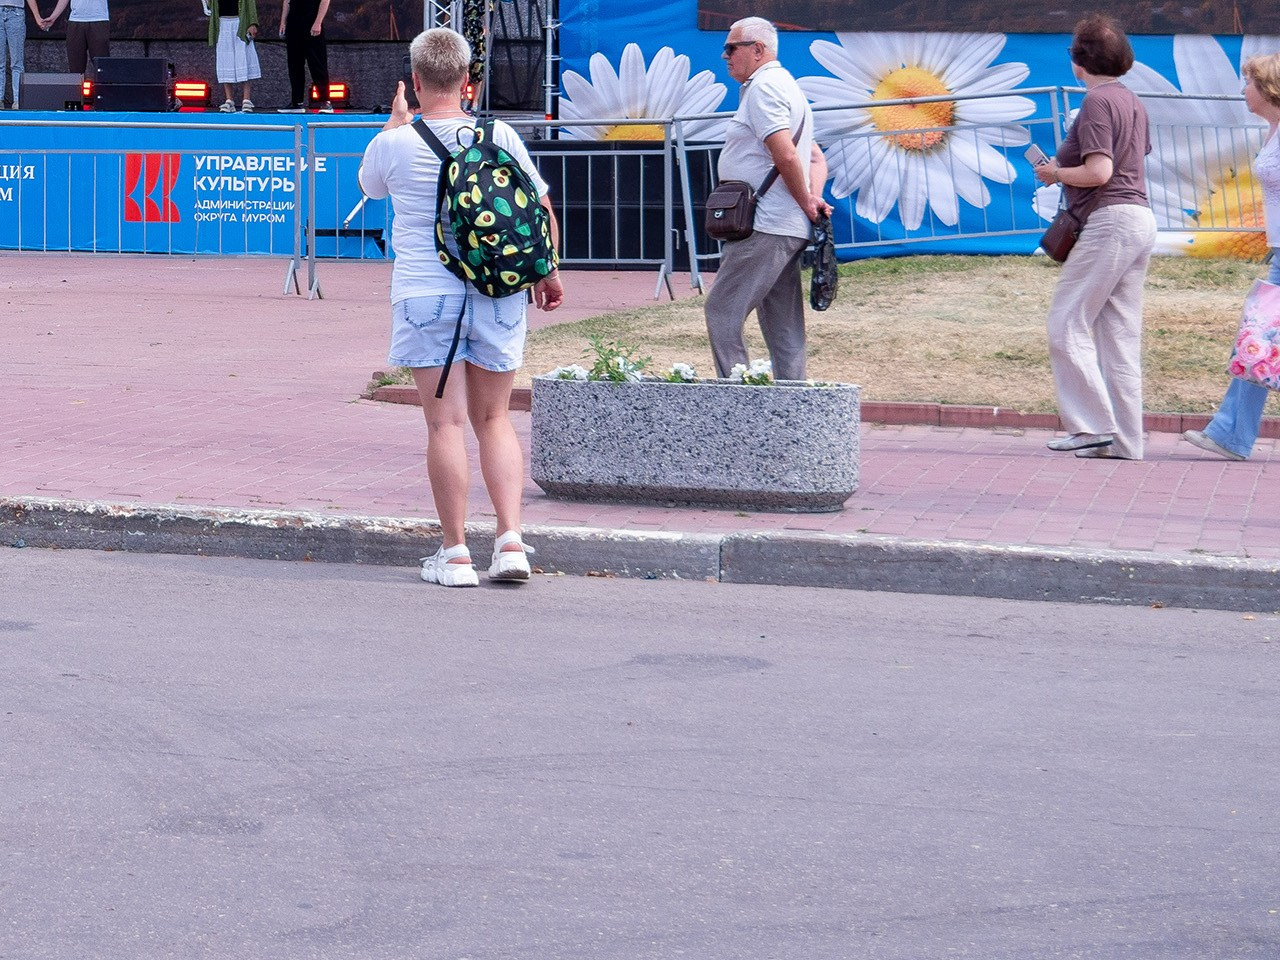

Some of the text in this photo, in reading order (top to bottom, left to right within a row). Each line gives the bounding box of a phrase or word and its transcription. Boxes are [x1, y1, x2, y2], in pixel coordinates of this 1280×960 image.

[193, 155, 327, 172] УПРАВЛЕНИЕ
[194, 212, 285, 223] ОКРУГА МУРОМ
